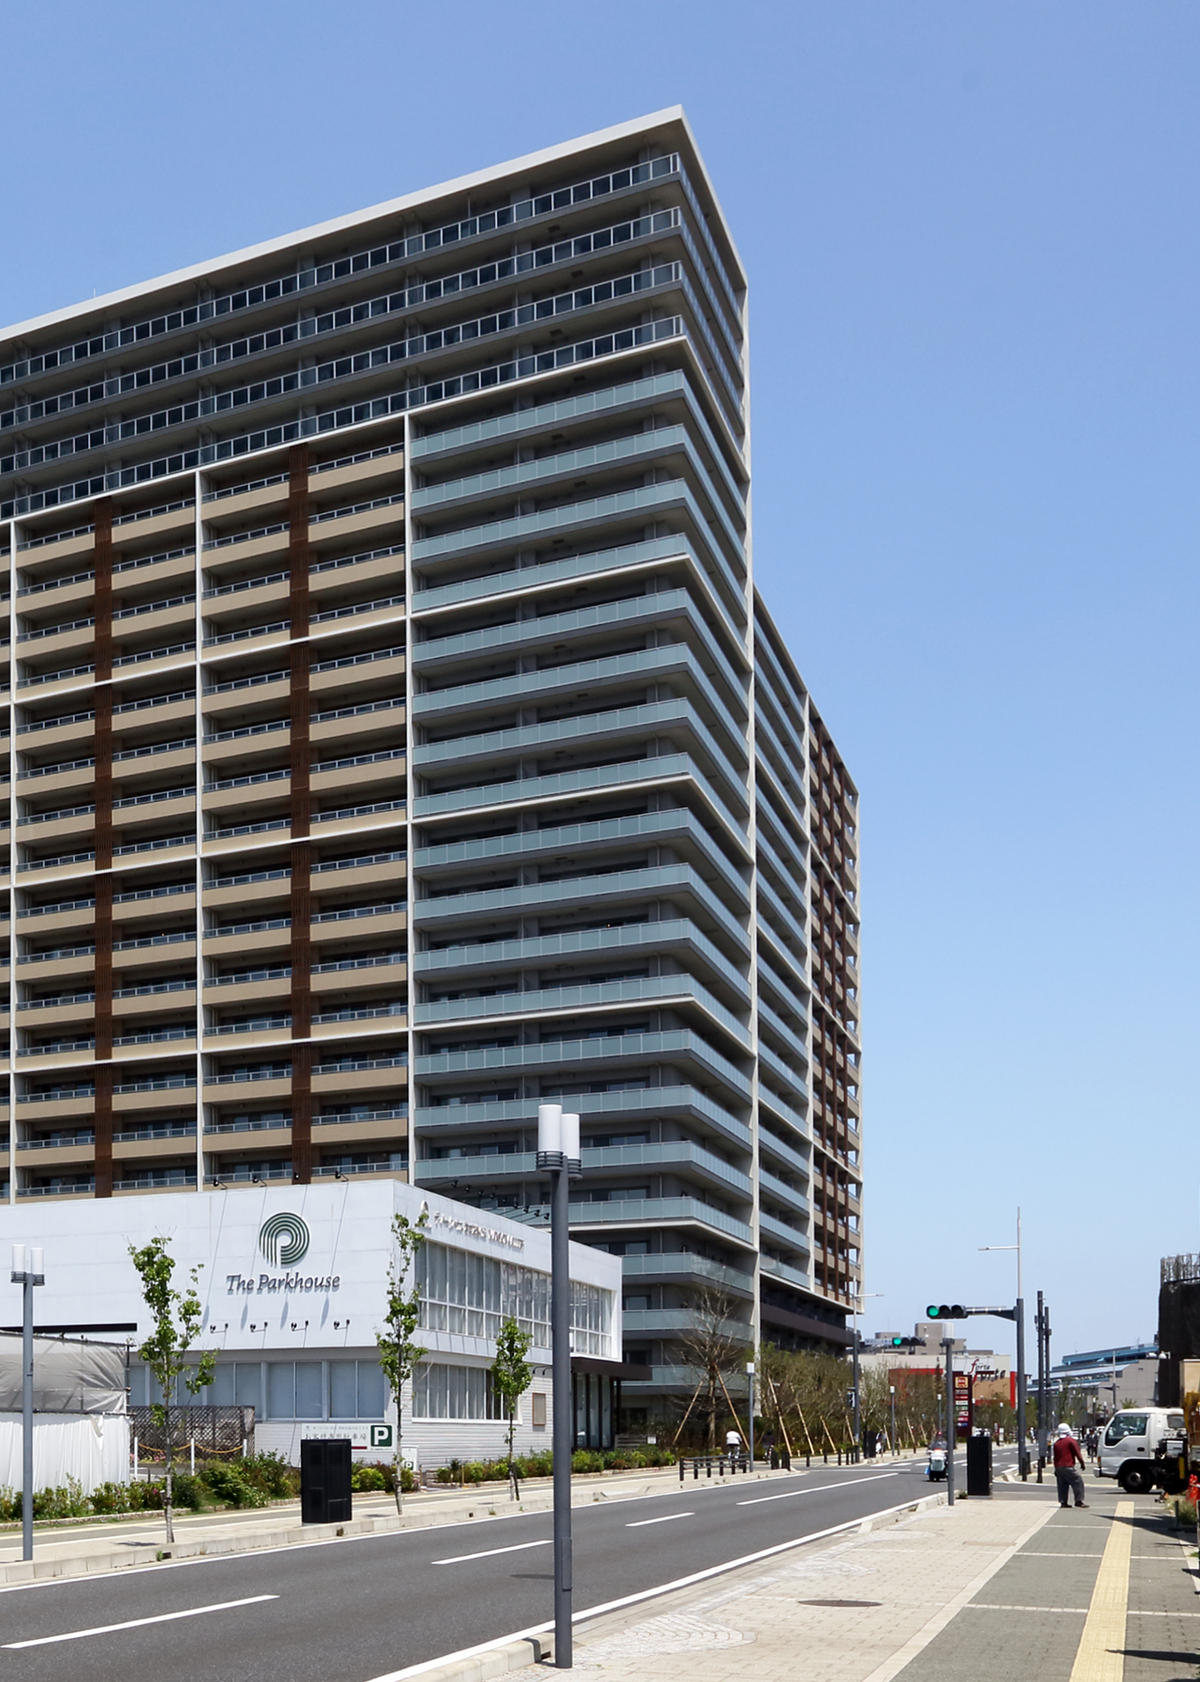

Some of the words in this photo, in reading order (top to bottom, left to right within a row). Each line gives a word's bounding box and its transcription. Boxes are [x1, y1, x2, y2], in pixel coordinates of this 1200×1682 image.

[226, 1274, 255, 1292] The
[257, 1272, 341, 1292] Parkhouse
[374, 1427, 389, 1446] P
